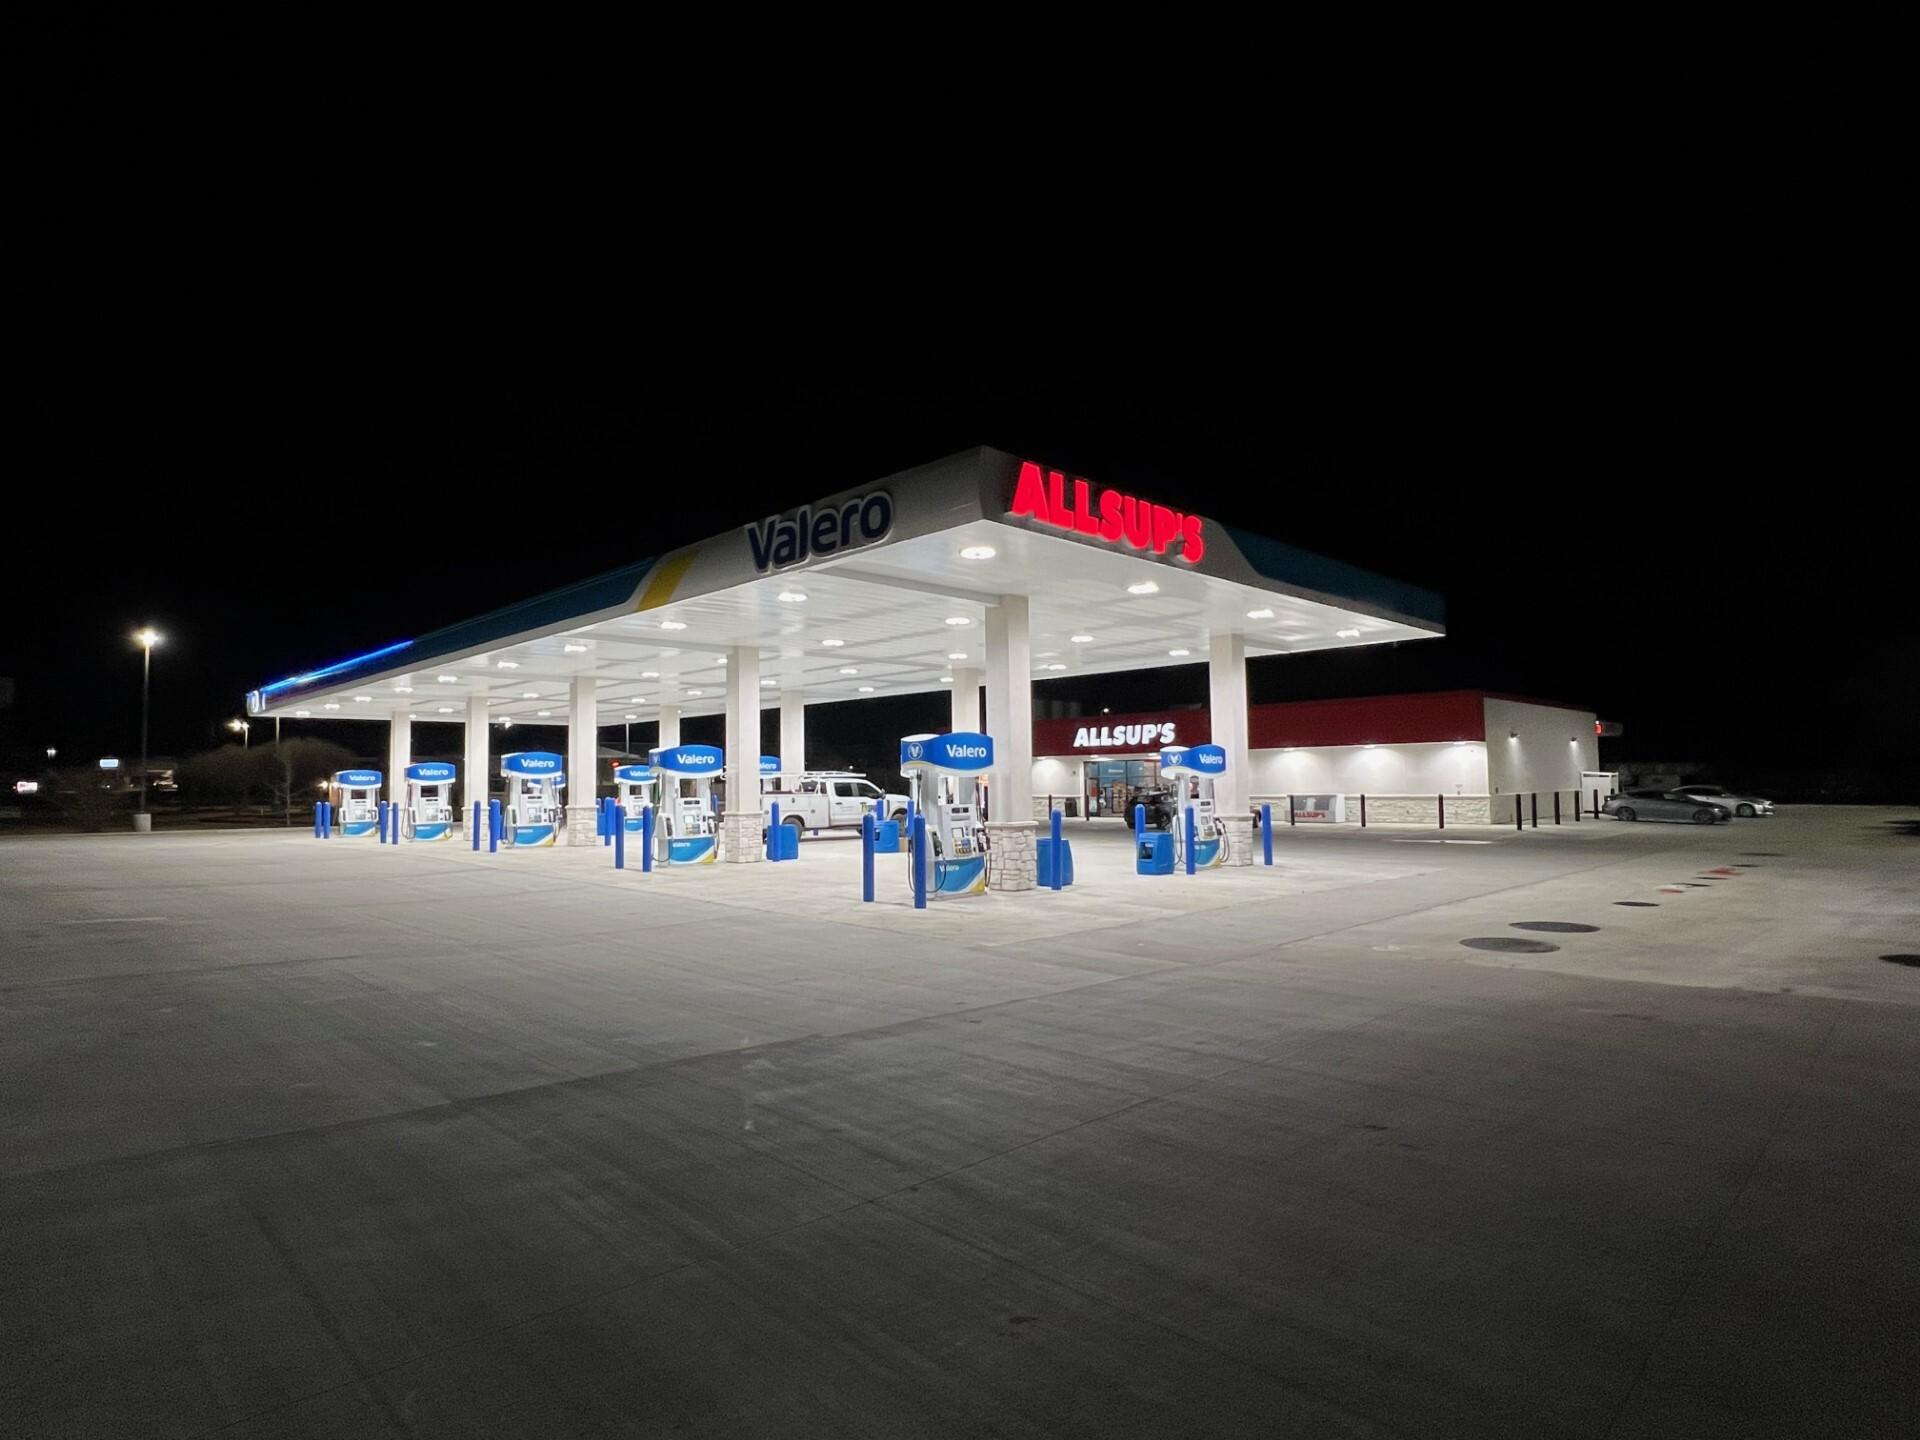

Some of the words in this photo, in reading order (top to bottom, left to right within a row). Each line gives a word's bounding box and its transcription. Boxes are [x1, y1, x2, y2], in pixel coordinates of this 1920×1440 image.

[1011, 460, 1204, 564] ALLSUP'S
[746, 490, 893, 573] Valero
[1073, 722, 1176, 748] ALLSUP'S
[946, 744, 987, 758] Valero
[520, 758, 556, 768] Valero
[676, 754, 715, 765] Valero
[1199, 753, 1224, 765] Valero
[418, 768, 450, 776] Valero
